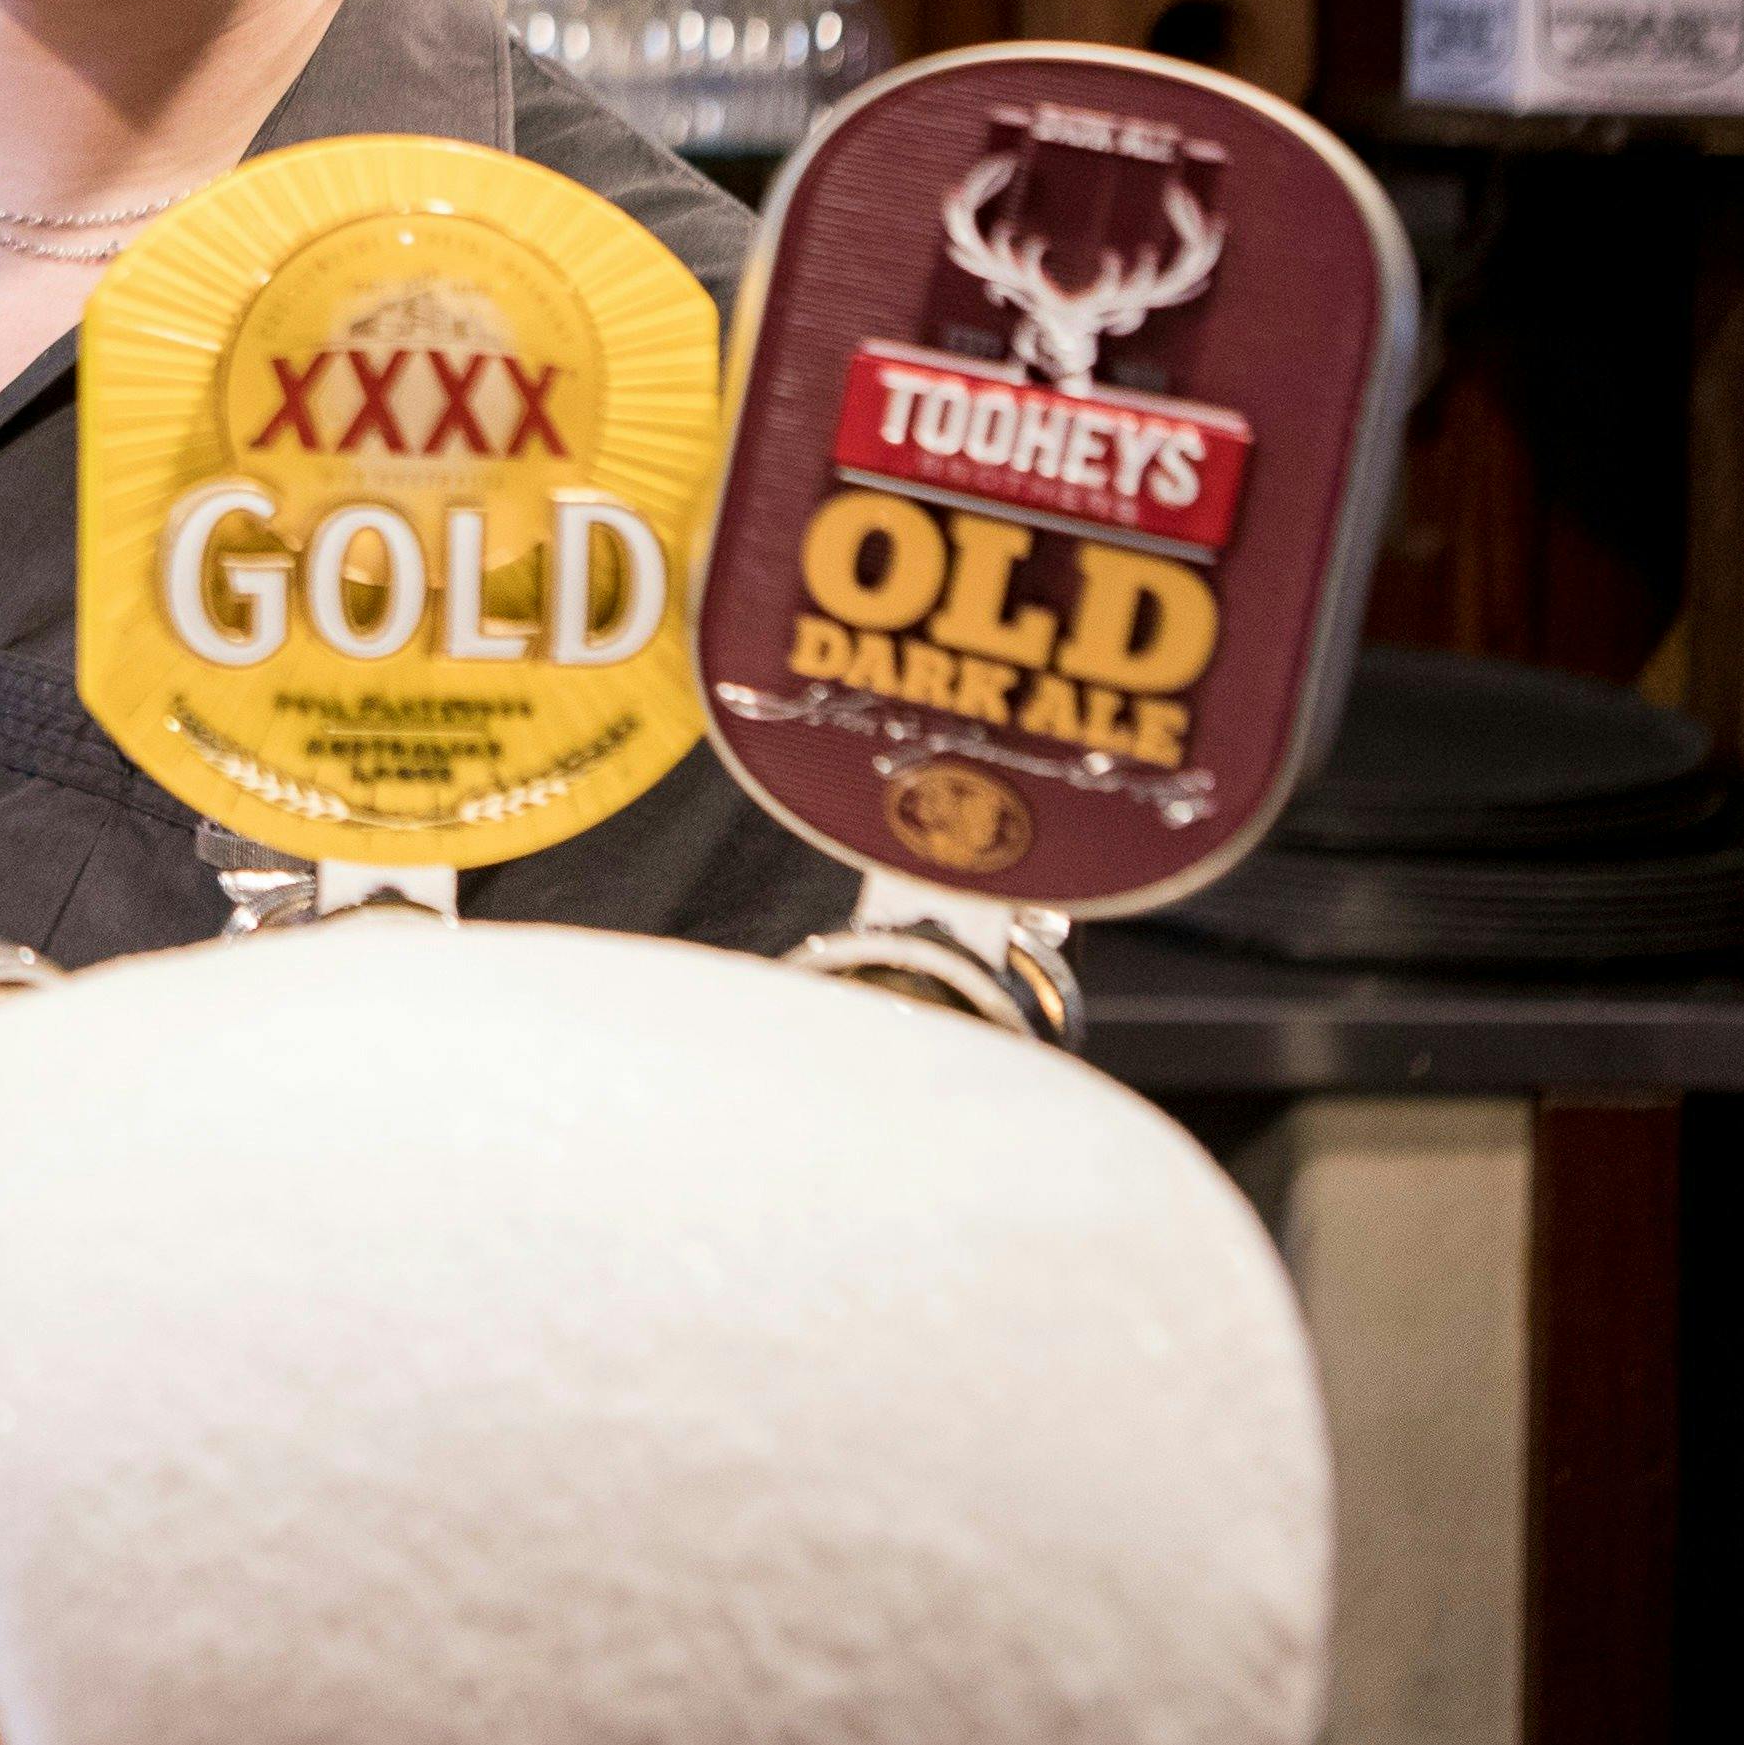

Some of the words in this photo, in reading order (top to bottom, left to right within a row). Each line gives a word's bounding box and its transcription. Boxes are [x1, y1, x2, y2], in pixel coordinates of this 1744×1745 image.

[247, 350, 571, 461] XXXX
[879, 367, 1206, 508] TOOHEYS
[166, 486, 668, 667] GOLD
[803, 491, 1220, 696] OLD
[790, 615, 1018, 727] DARK
[1021, 674, 1191, 770] ALE
